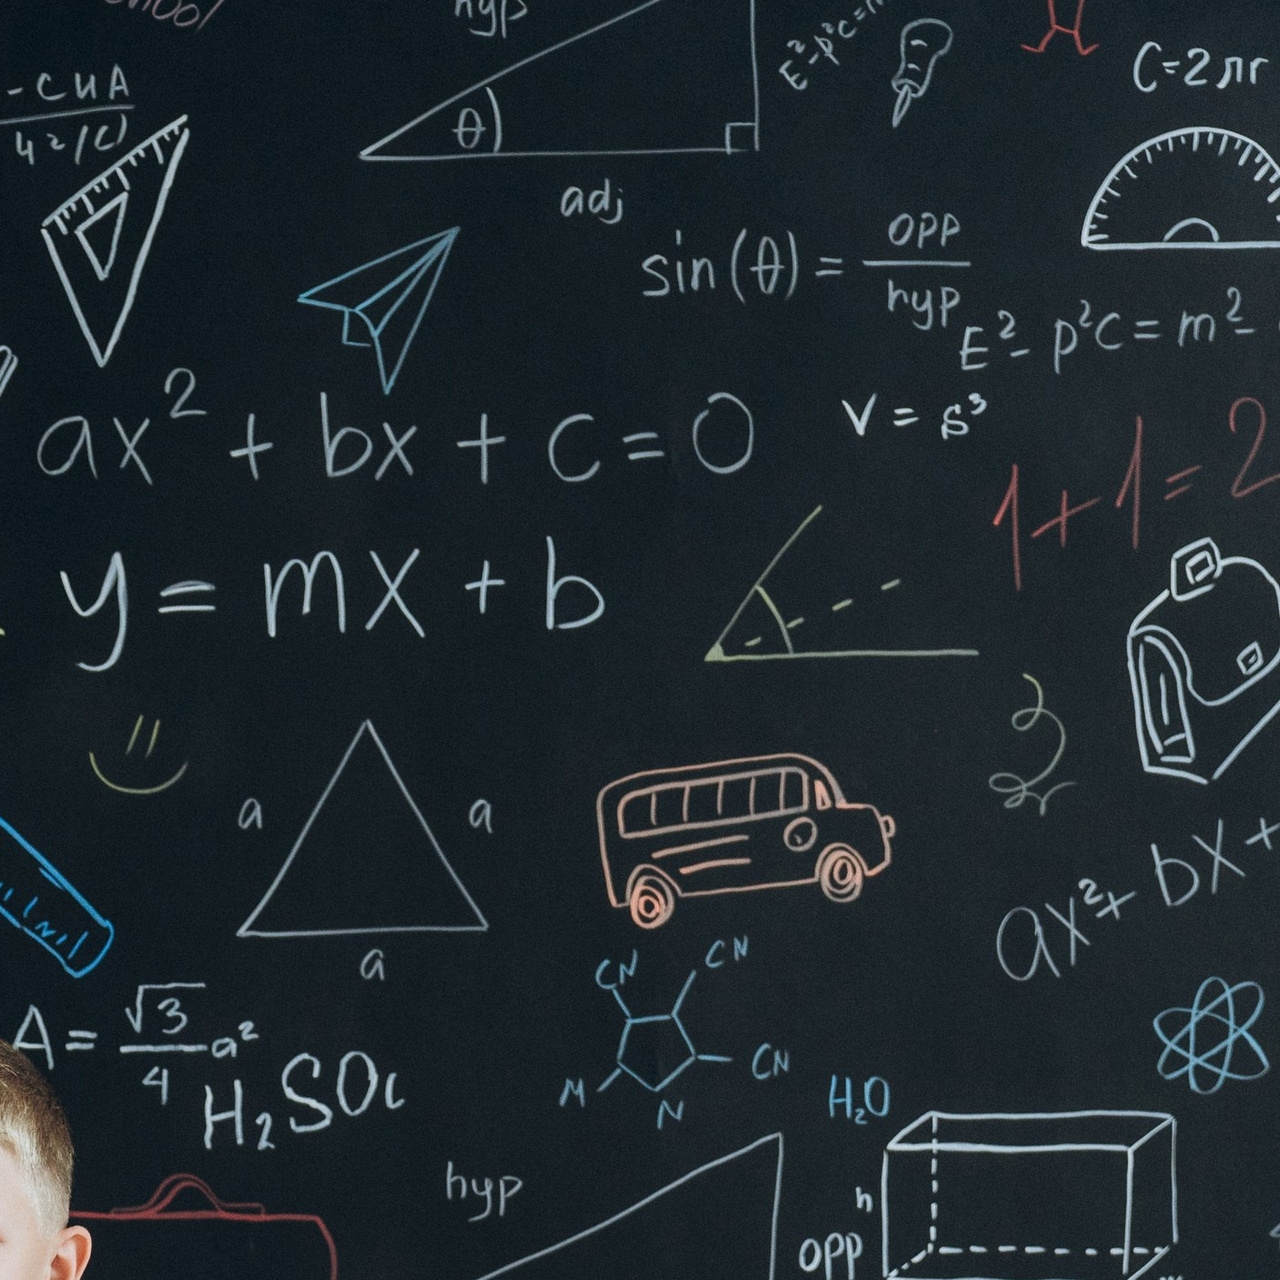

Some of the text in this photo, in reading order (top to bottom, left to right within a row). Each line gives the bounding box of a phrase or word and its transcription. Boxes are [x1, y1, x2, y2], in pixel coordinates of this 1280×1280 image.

[559, 177, 624, 226] adj
[886, 278, 961, 332] hyp
[545, 534, 606, 631] b
[237, 797, 264, 830] a
[445, 1160, 524, 1223] hyp
